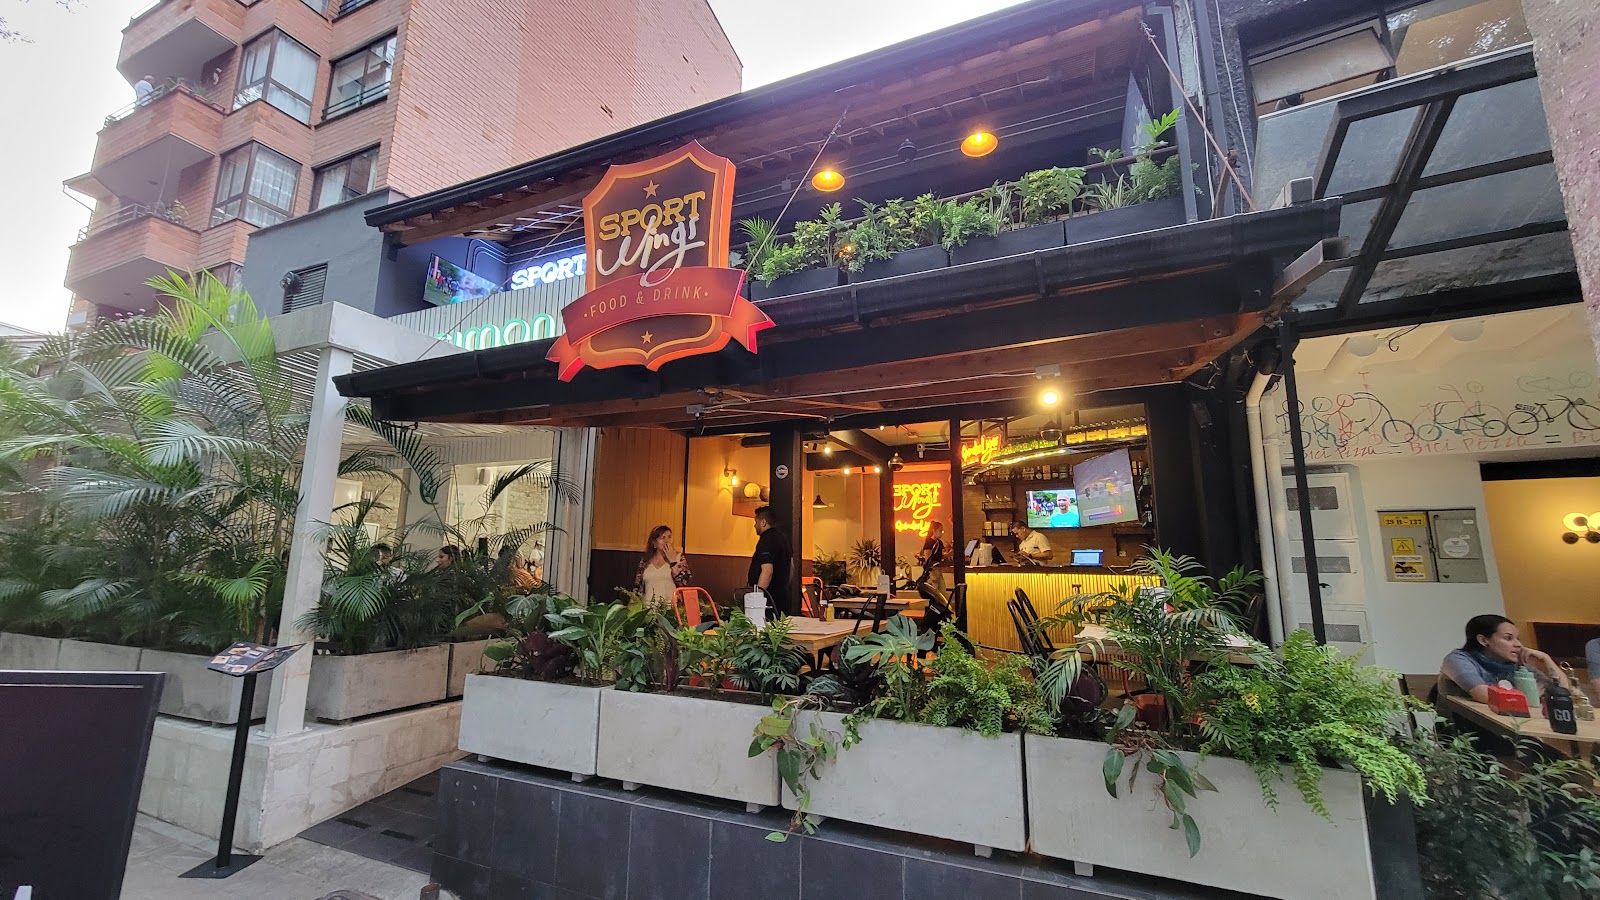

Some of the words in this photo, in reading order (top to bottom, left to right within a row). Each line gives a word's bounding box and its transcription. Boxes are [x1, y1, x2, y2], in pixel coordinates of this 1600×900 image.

[599, 191, 706, 241] SPORT
[596, 215, 706, 287] Wings
[510, 253, 587, 291] SPORT
[590, 295, 627, 317] FOOD
[636, 290, 645, 305] &
[653, 286, 702, 302] DRINK
[434, 312, 556, 351] imon
[893, 482, 941, 497] SPORT
[1554, 708, 1572, 722] GO
